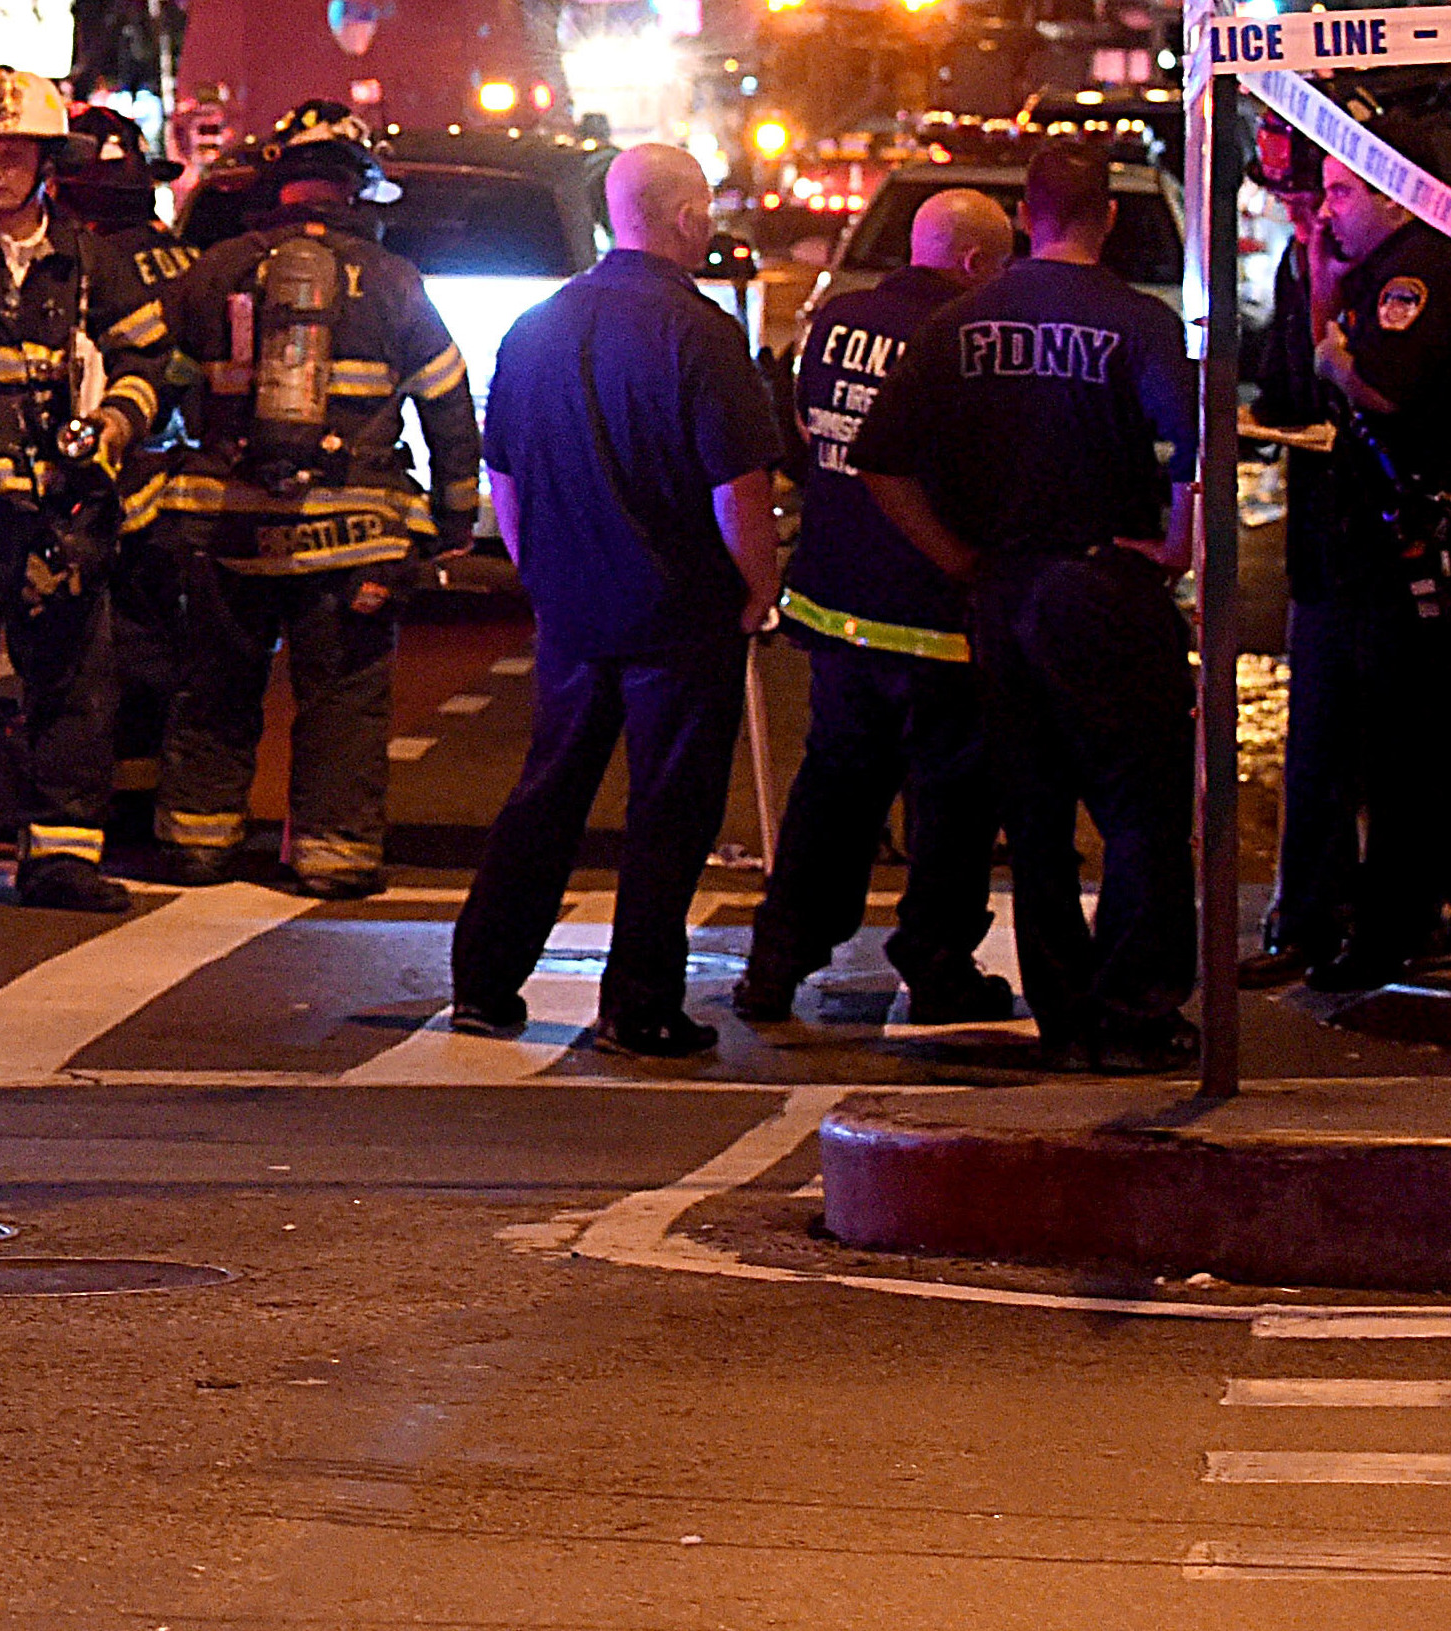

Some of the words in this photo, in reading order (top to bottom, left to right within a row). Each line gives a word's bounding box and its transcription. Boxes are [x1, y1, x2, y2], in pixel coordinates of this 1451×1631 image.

[1211, 24, 1285, 64] LICE
[1313, 19, 1388, 58] LINE
[959, 320, 1120, 384] FDNY
